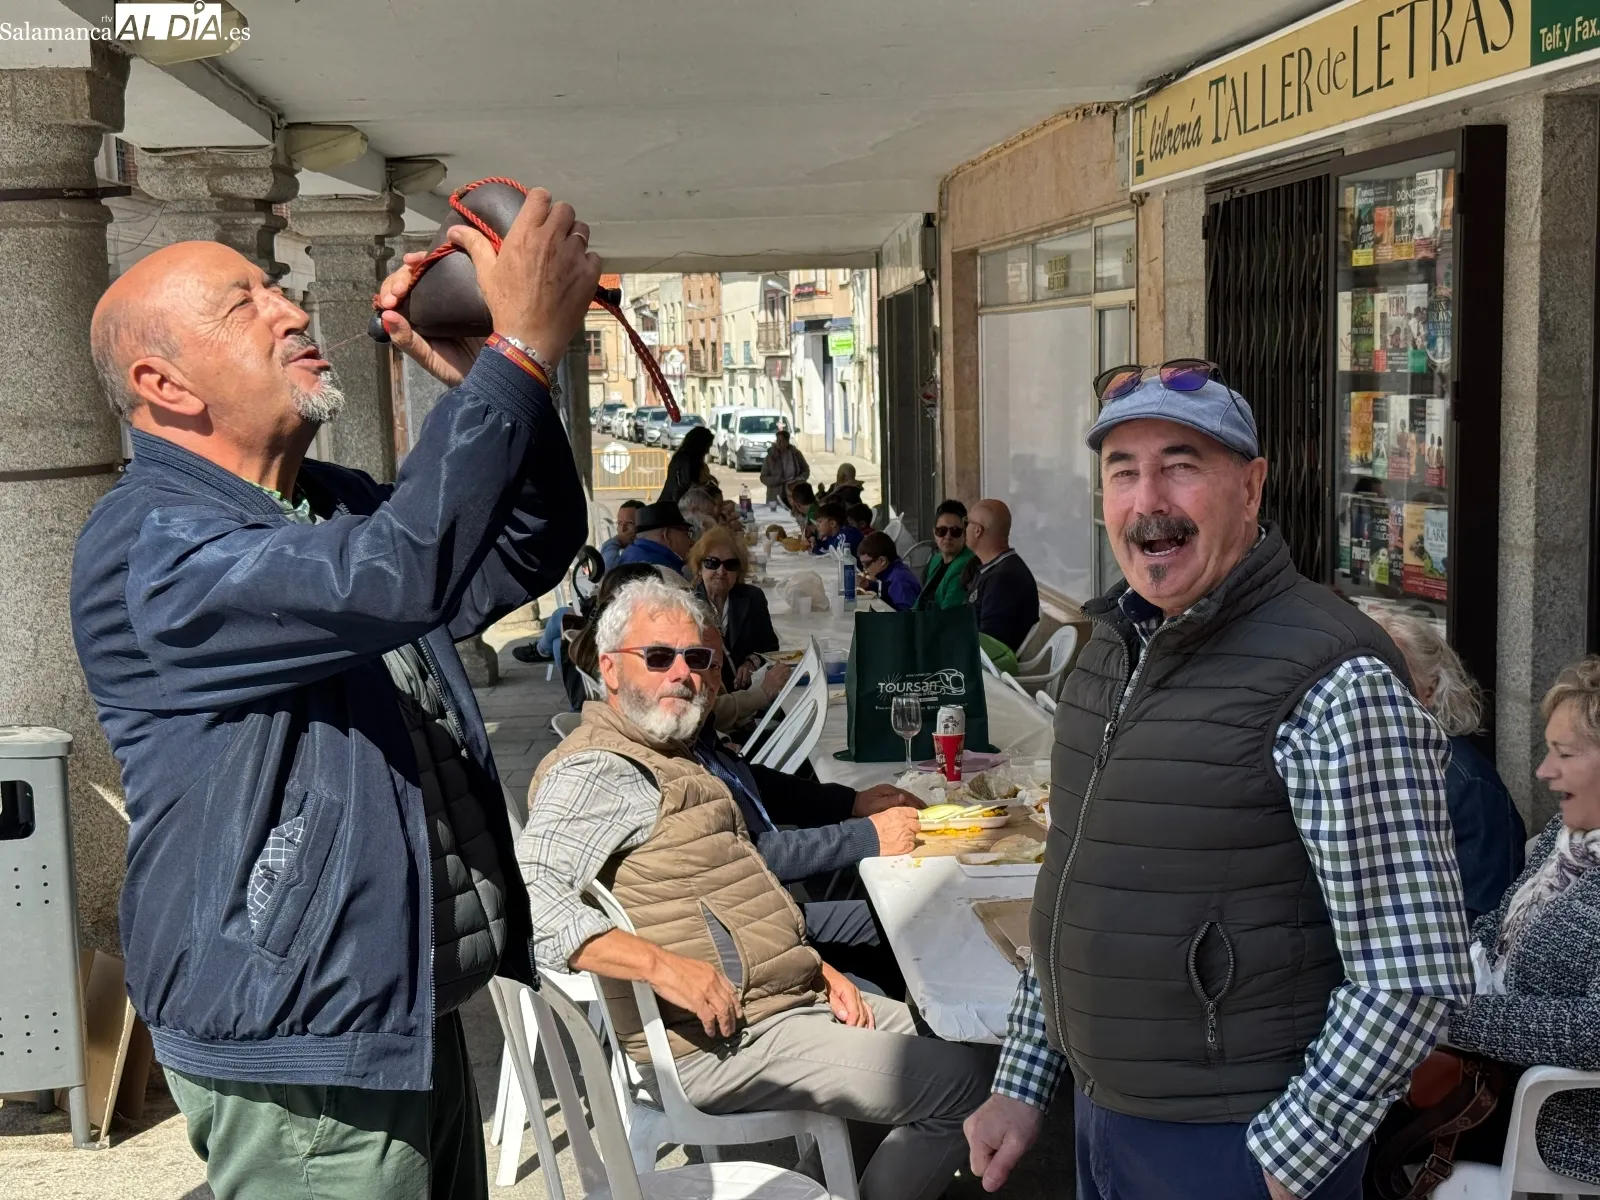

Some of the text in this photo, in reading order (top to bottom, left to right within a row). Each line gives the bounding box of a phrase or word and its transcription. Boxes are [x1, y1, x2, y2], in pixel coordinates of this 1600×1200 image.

[1149, 97, 1203, 163] librería
[1208, 47, 1314, 145] TALLER
[1317, 47, 1348, 96] de
[1352, 0, 1514, 98] LETRAS
[1396, 189, 1417, 201] DOND
